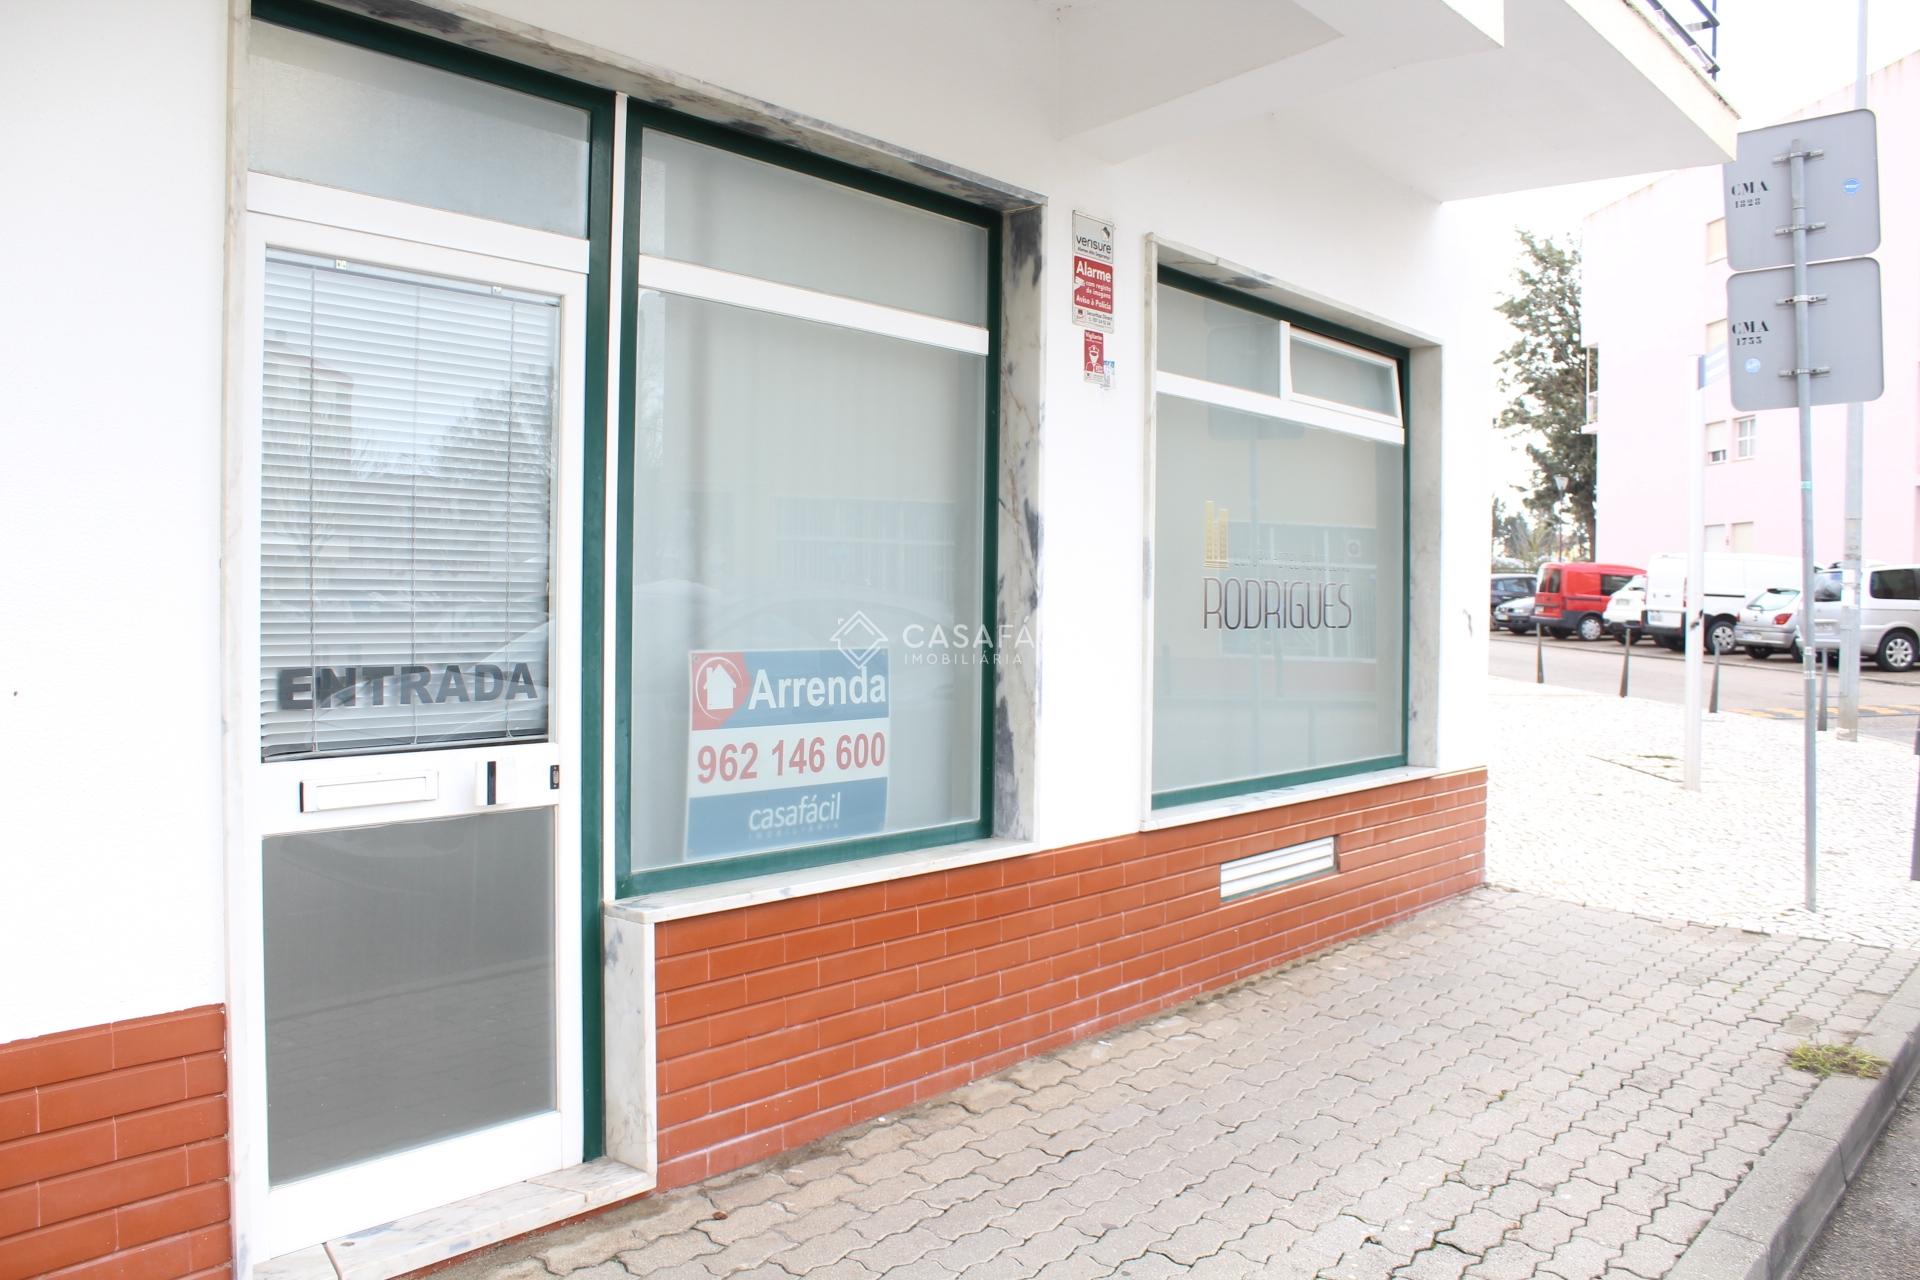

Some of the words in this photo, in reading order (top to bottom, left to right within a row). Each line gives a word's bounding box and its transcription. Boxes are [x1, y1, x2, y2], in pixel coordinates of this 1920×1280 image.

[1731, 181, 1769, 196] CMA
[1076, 234, 1111, 254] verisure
[1076, 260, 1111, 283] Alarme
[1732, 320, 1769, 334] CMA
[1203, 577, 1352, 630] RODRIGUES
[277, 662, 538, 711] ENTRADA
[748, 666, 886, 710] Arrenda
[697, 742, 758, 784] 962
[771, 736, 826, 776] 146
[835, 732, 885, 770] 600
[748, 791, 840, 831] casafácil
